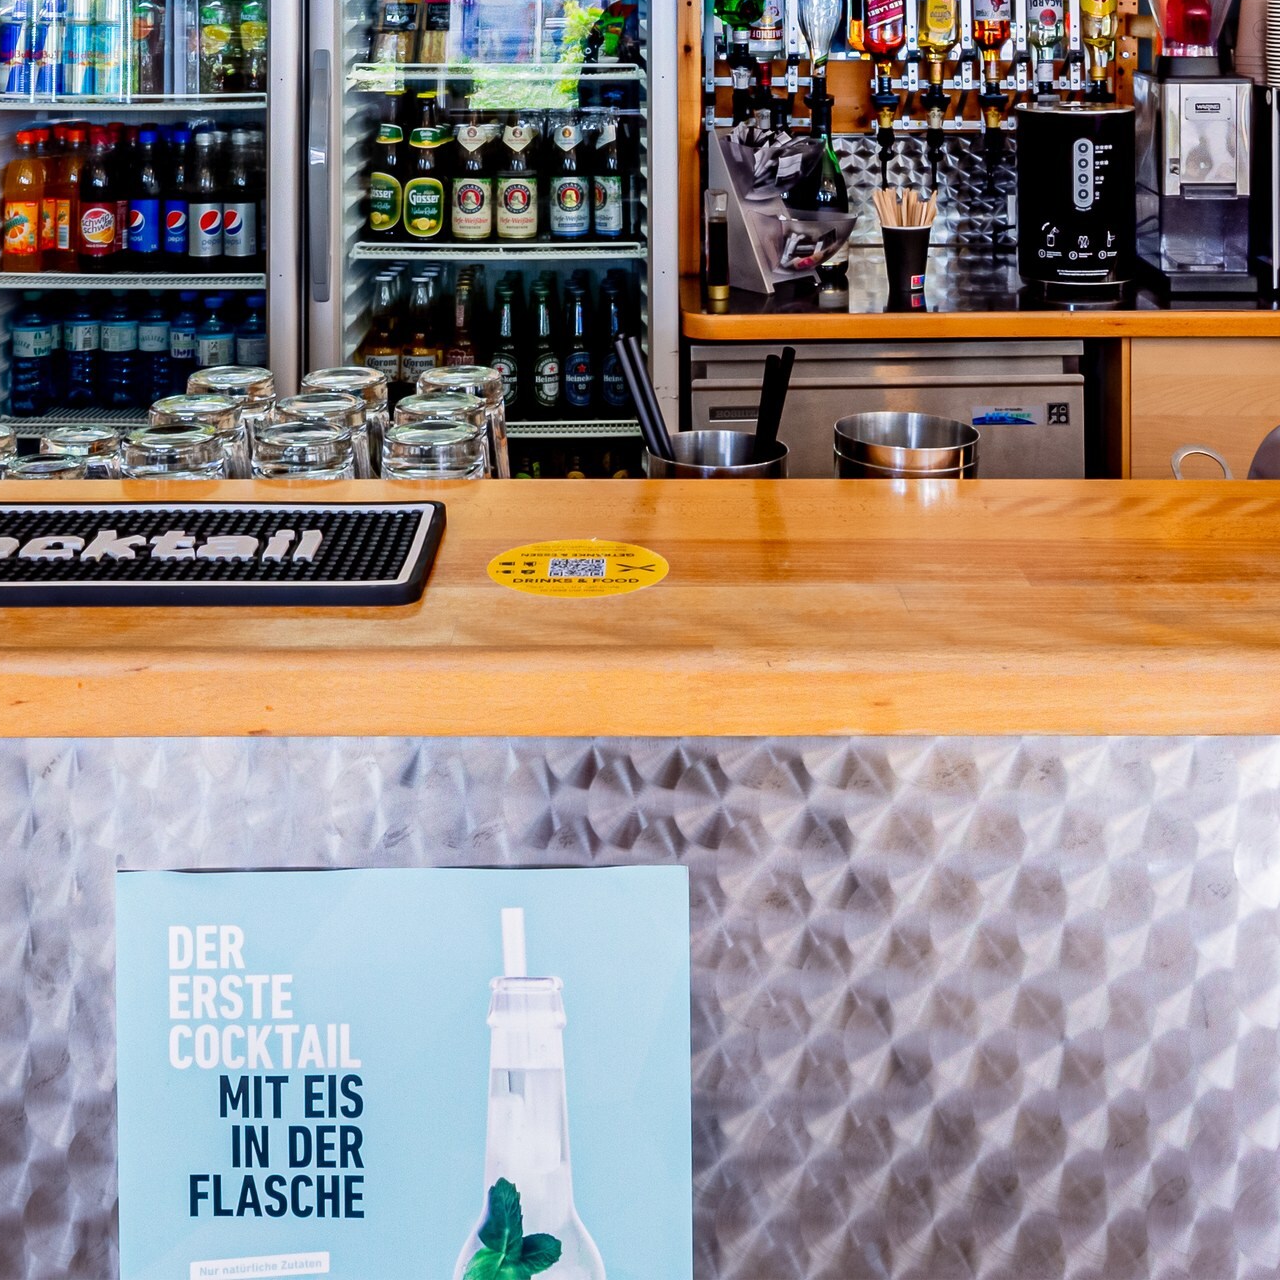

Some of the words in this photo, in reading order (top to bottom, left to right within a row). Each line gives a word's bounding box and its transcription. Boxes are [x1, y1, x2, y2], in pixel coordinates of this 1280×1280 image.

[371, 189, 394, 199] össer
[409, 189, 440, 206] Gösser
[367, 357, 397, 368] Corona
[403, 357, 433, 368] Corona
[168, 925, 245, 970] DER
[168, 974, 293, 1019] ERSTE
[168, 1023, 362, 1070] COCKTAIL
[219, 1074, 288, 1119] MIT
[304, 1074, 364, 1119] EIS
[231, 1125, 269, 1169] IN
[288, 1125, 364, 1169] DER
[190, 1173, 365, 1218] FLASCHE
[199, 1267, 218, 1277] Nur
[222, 1261, 277, 1275] natürliche
[280, 1258, 322, 1270] Zutaten
